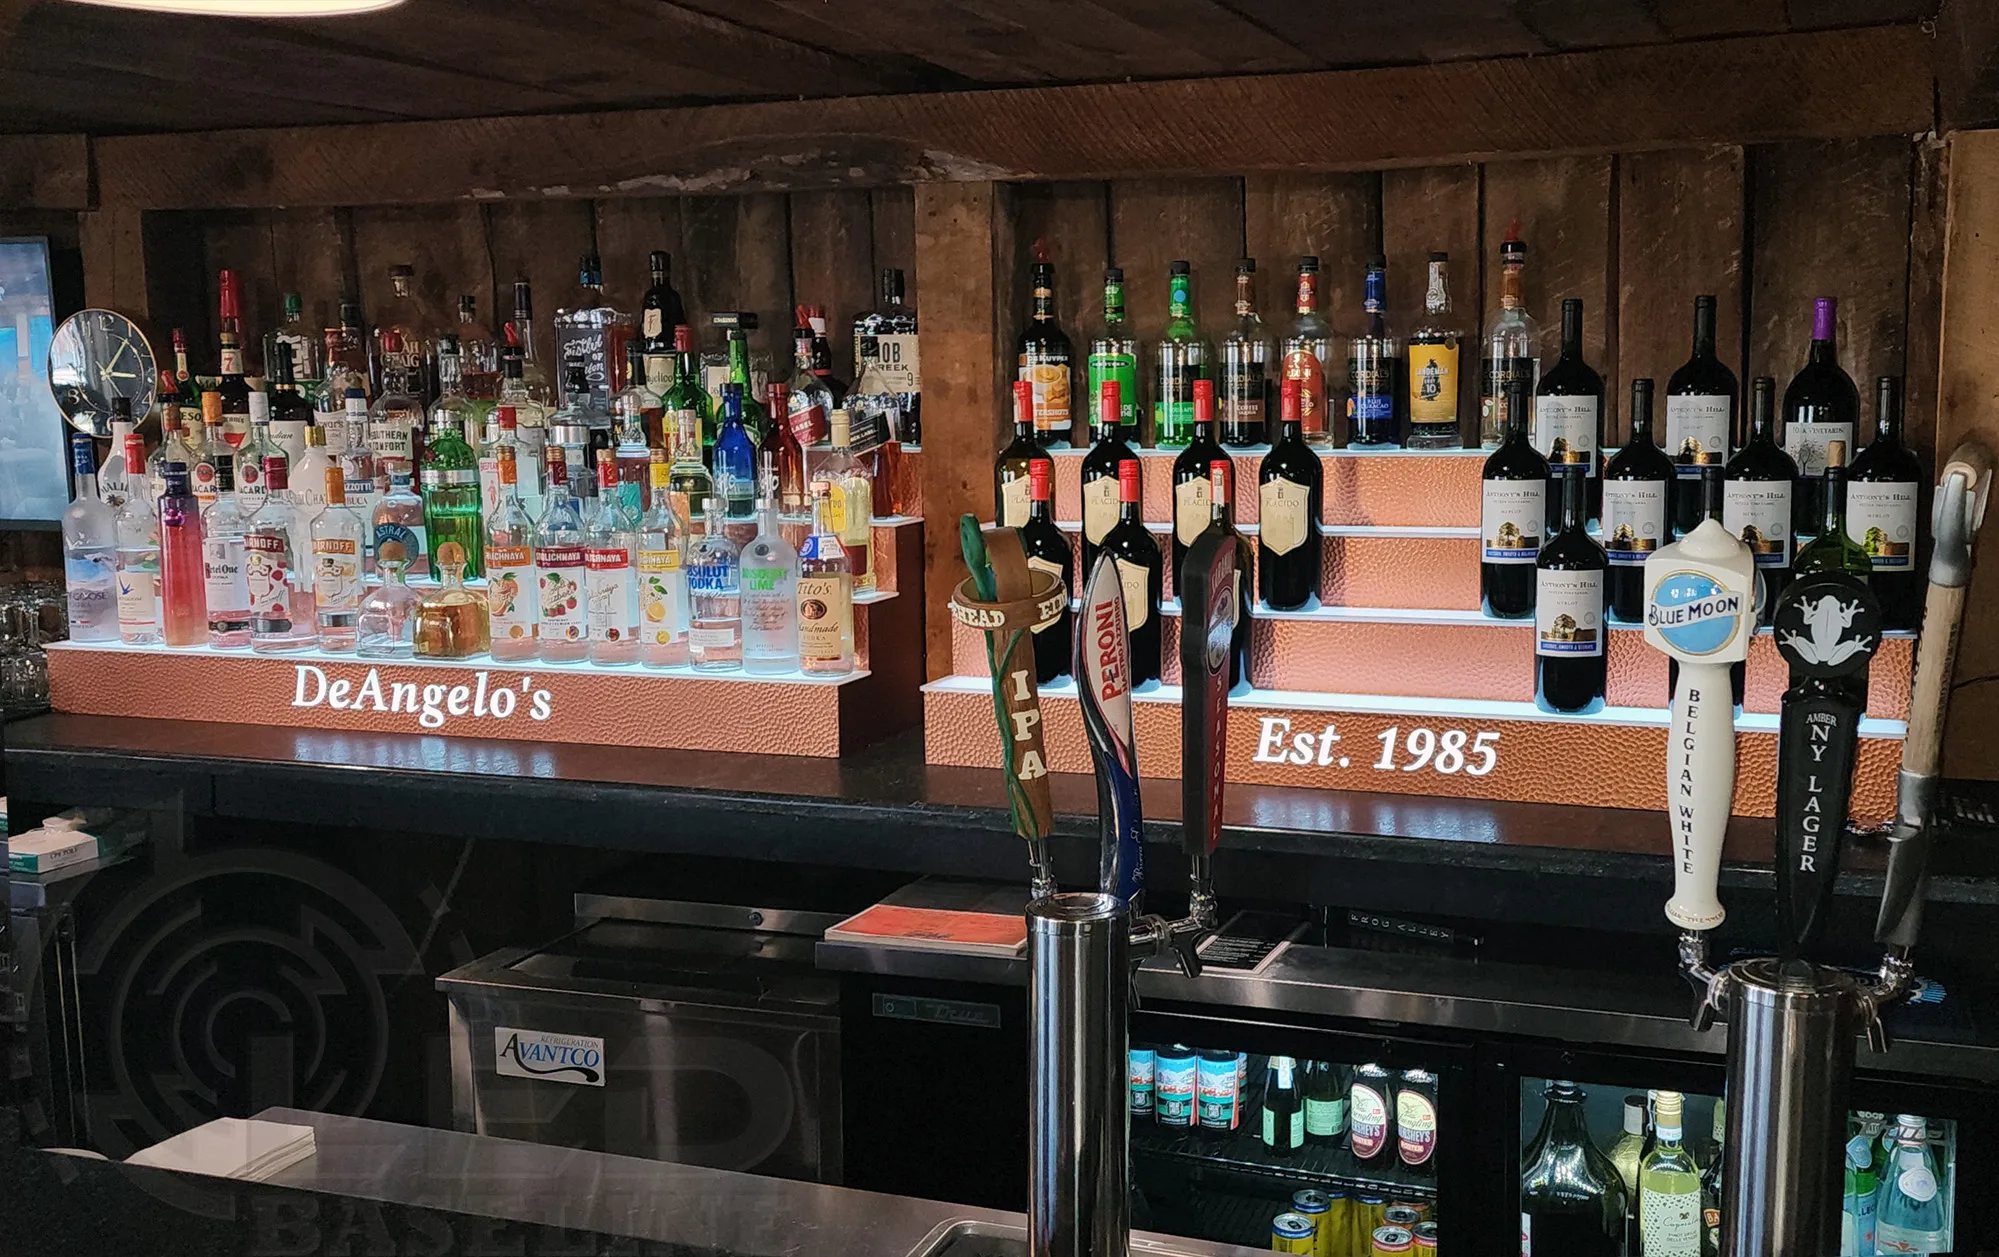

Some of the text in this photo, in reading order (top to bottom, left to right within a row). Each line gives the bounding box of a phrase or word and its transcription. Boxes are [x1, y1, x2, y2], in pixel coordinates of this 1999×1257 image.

[224, 357, 232, 371] 7
[878, 363, 909, 372] REEK
[907, 372, 913, 386] 9
[1426, 383, 1437, 394] 10
[67, 388, 80, 405] 8
[1522, 490, 1540, 498] HILL
[1637, 490, 1658, 498] HILL
[1766, 491, 1786, 499] HILL
[1892, 493, 1912, 501] HILL
[376, 524, 406, 539] ASTRAL
[222, 562, 238, 574] One
[797, 581, 832, 596] Tito's
[1579, 580, 1598, 588] HILL
[1649, 595, 1739, 627] BLUE MOON
[1096, 599, 1122, 702] PERONI
[1113, 595, 1129, 698] NASTRO AZZURRO
[292, 664, 552, 729] DeAngelo's
[1011, 669, 1048, 781] IPA
[1805, 711, 1838, 727] AMBER
[1252, 717, 1501, 776] Est. 1985
[1211, 674, 1222, 841] SEASONAL
[1678, 687, 1701, 875] BELGIAN WHITE
[1799, 724, 1830, 873] NY LAGER
[1350, 913, 1391, 929] FROG
[541, 1035, 600, 1049] REFRIGERATION
[498, 1032, 601, 1069] AVANTCO
